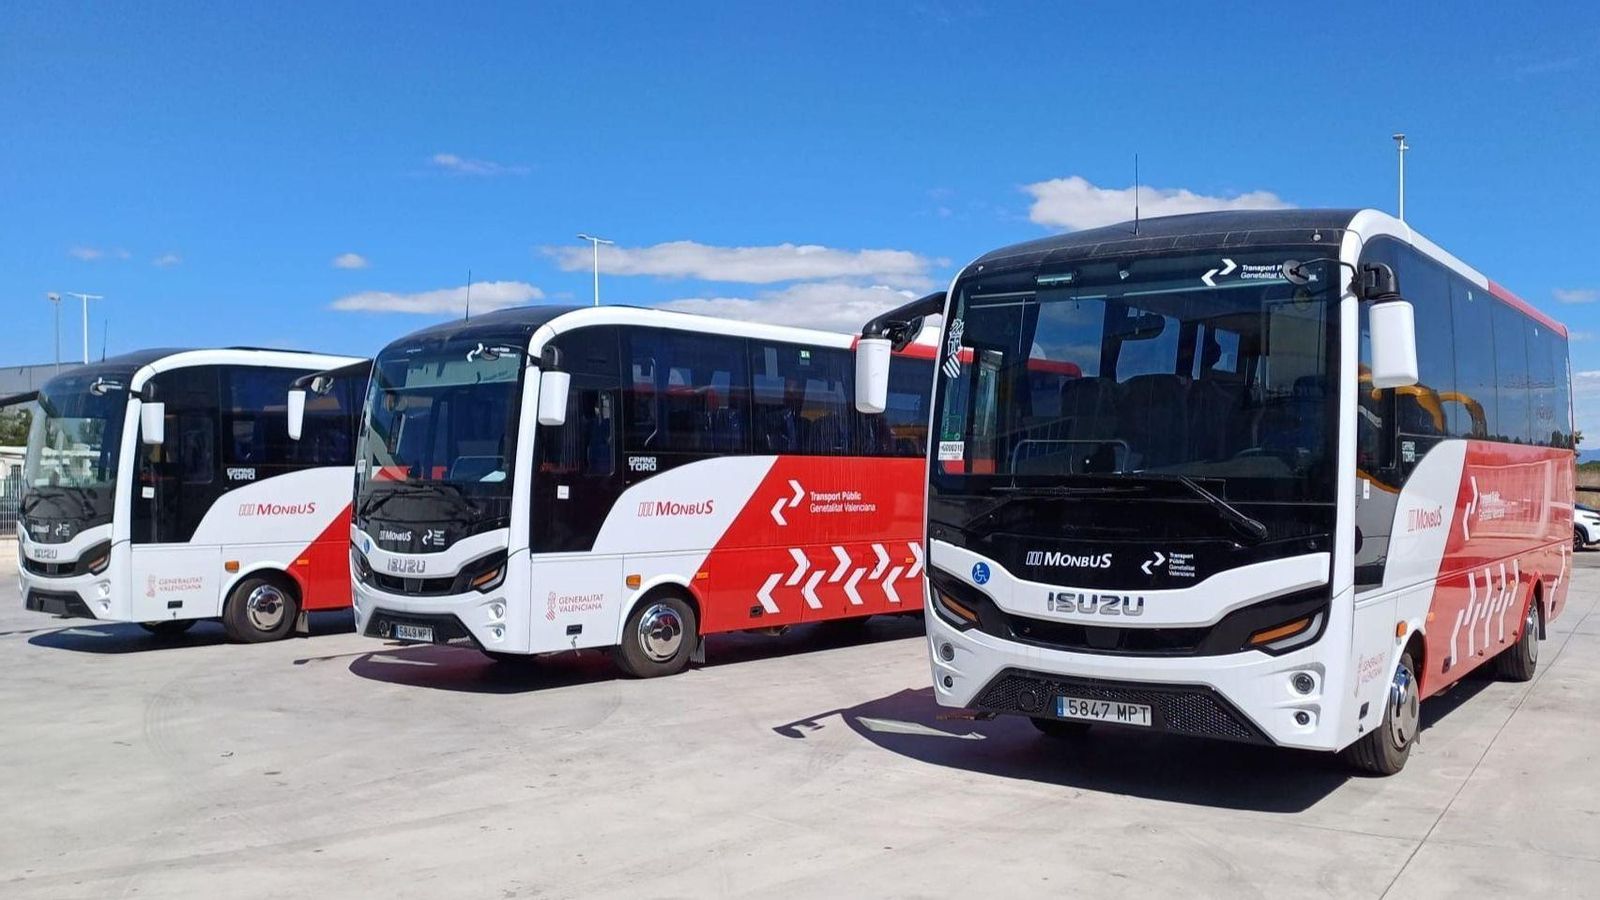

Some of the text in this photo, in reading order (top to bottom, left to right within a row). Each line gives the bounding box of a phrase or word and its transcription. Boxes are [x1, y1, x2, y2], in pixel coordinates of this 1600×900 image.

[1241, 264, 1276, 272] Transport
[628, 456, 657, 464] GRAND
[629, 463, 657, 471] TORO
[810, 491, 840, 502] Transport
[844, 502, 876, 512] Valenciana
[387, 558, 426, 573] ISUZU
[558, 594, 604, 604] GENERALITAT
[1047, 591, 1144, 617] ISUZU
[558, 603, 602, 612] VALENCIANA
[1068, 699, 1149, 723] 5847 MPT
